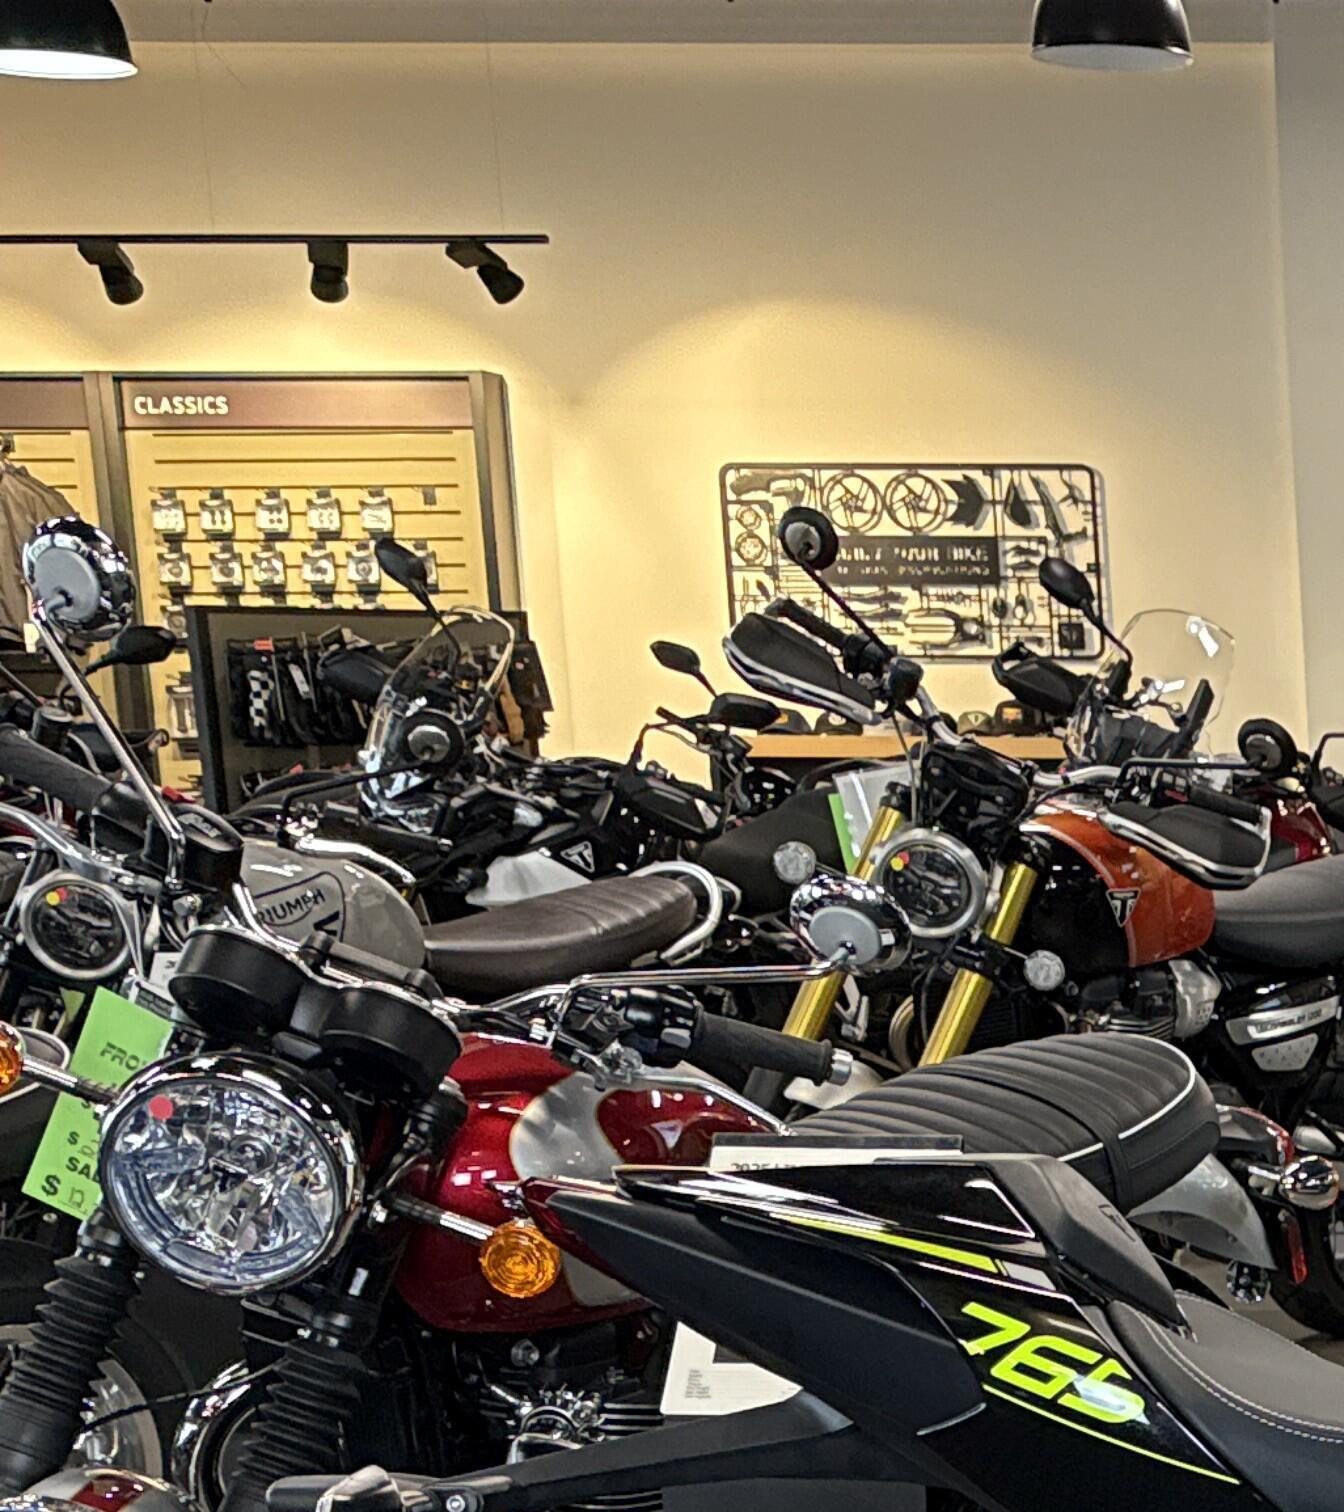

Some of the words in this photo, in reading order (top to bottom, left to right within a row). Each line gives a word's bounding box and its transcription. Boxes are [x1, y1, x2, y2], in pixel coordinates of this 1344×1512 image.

[133, 395, 229, 415] CLASSICS
[256, 888, 326, 926] RIUMPH
[99, 1042, 147, 1073] FRO
[65, 1156, 100, 1184] SAL
[41, 1174, 61, 1197] $
[961, 1301, 1146, 1424] 765
